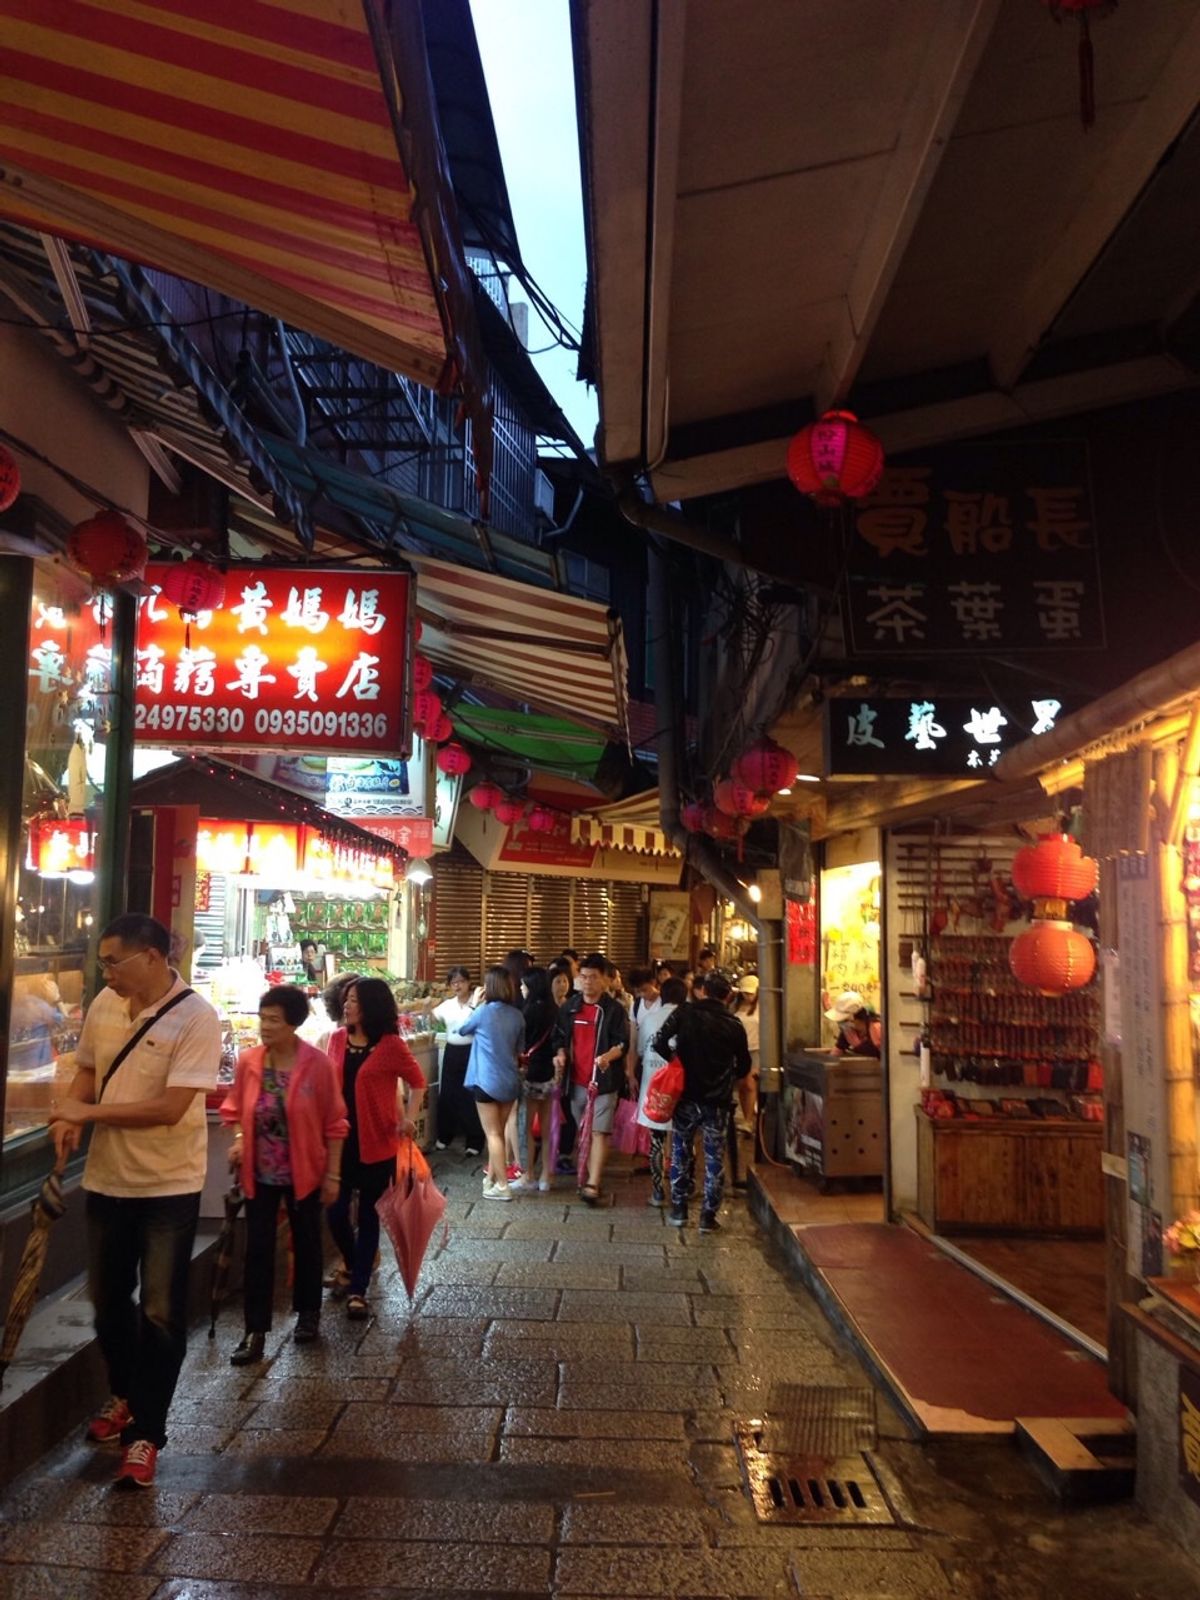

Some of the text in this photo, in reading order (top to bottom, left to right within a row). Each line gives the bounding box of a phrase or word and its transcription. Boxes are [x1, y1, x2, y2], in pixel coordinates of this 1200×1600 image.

[139, 581, 386, 635] 九黃媽媽
[865, 581, 1085, 643] 茶葉蛋
[255, 708, 387, 738] 0935091336
